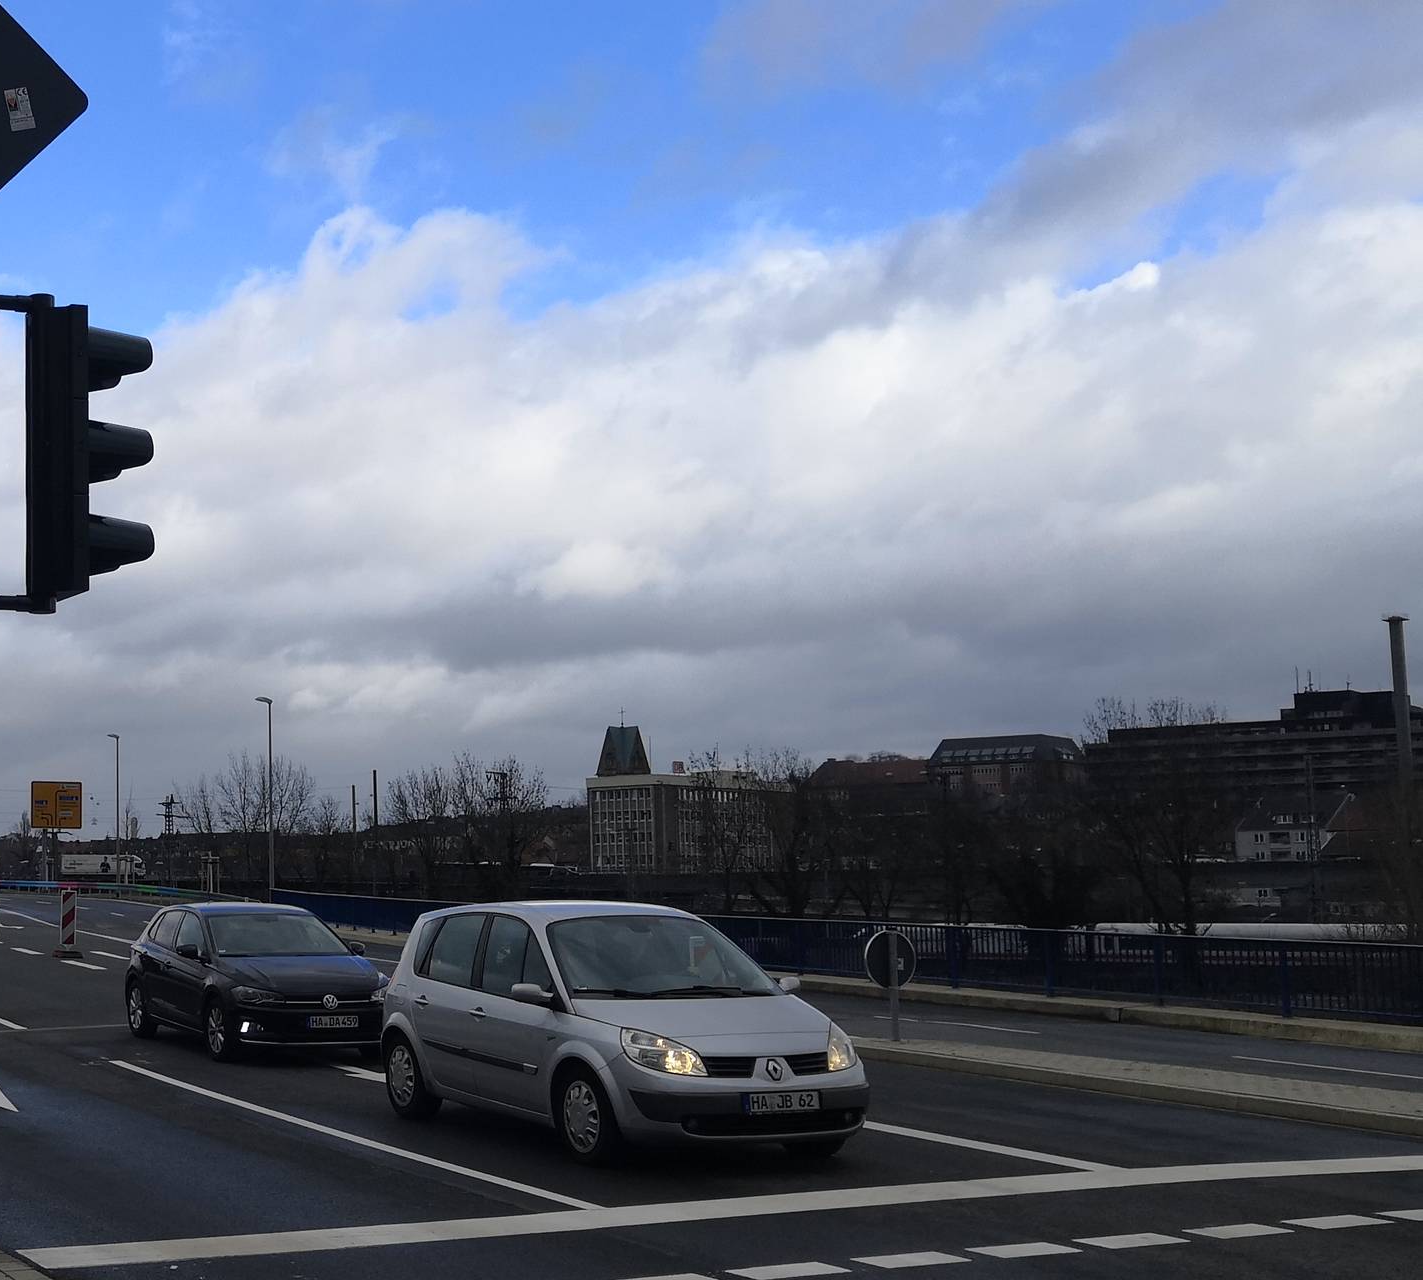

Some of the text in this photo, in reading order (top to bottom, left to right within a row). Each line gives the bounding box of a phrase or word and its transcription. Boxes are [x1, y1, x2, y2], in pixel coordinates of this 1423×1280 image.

[750, 1093, 815, 1110] HA JB 62
